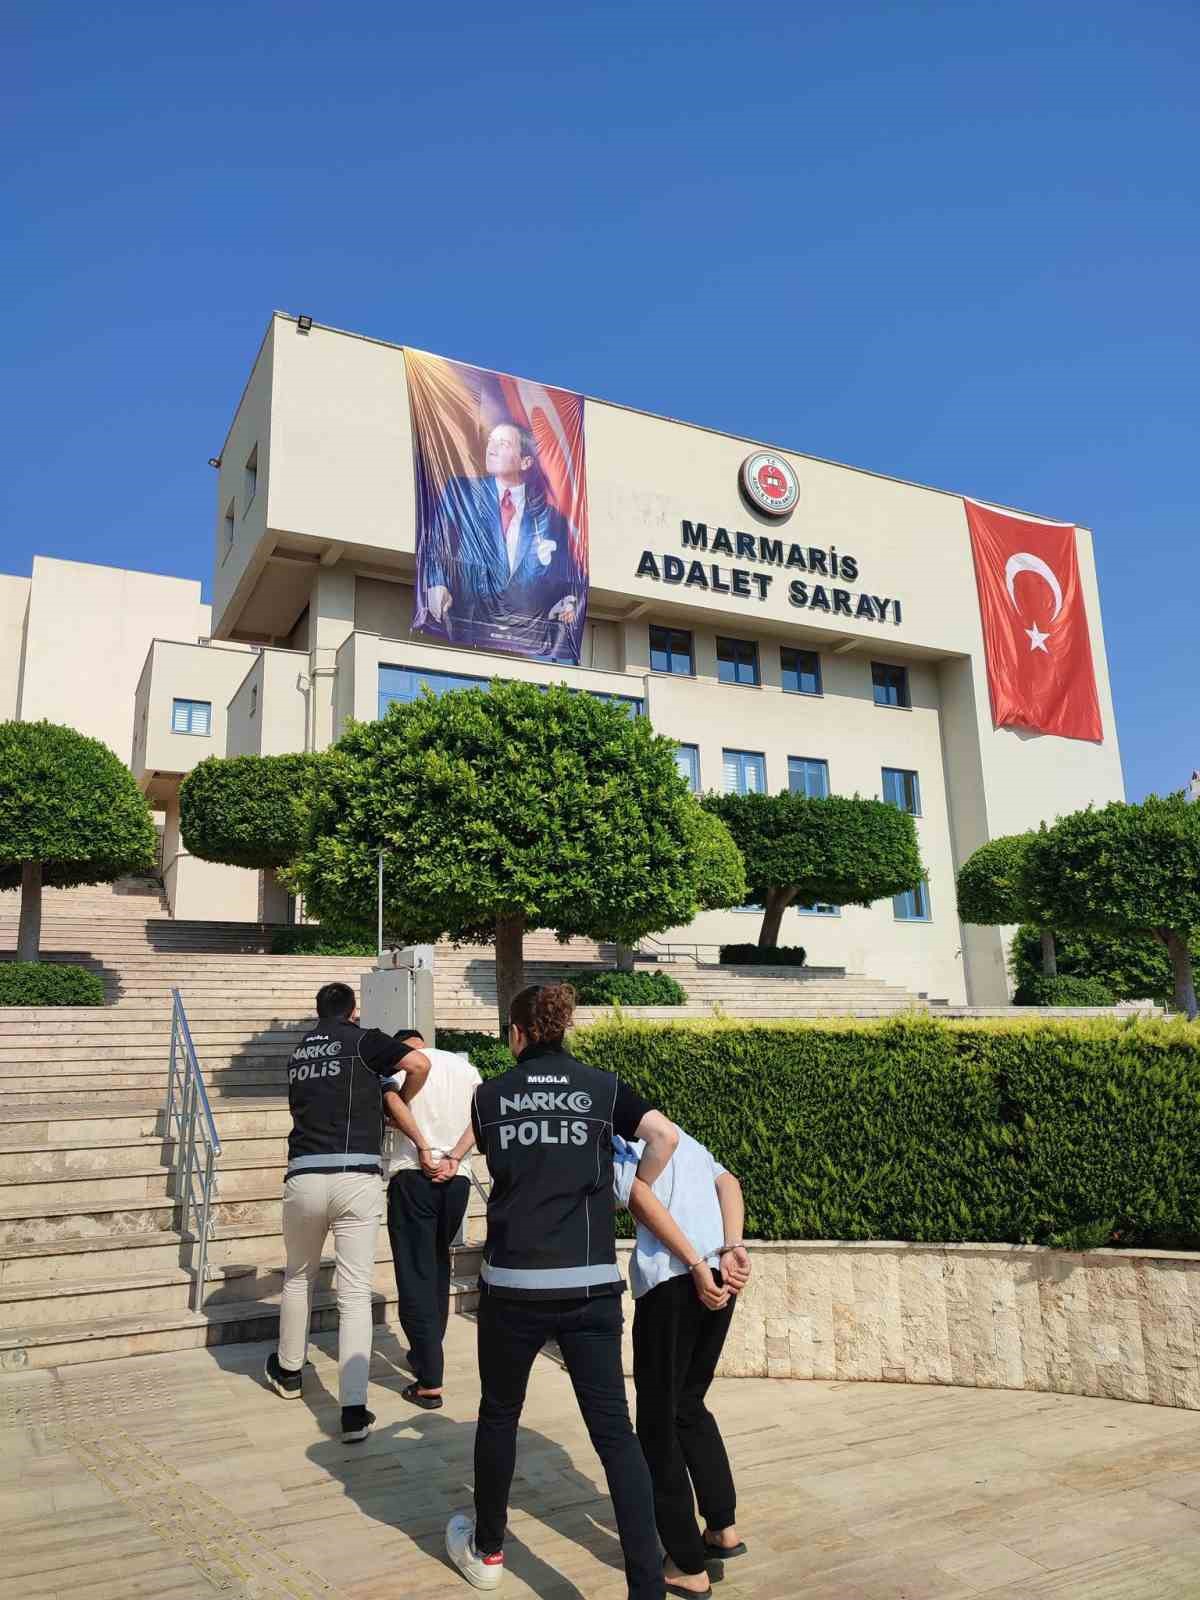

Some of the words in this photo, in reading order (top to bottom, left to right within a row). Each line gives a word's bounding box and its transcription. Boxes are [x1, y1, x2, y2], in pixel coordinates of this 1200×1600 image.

[681, 520, 859, 582] MARMARİS
[635, 550, 773, 599] ADALET
[788, 580, 902, 624] SARAYI
